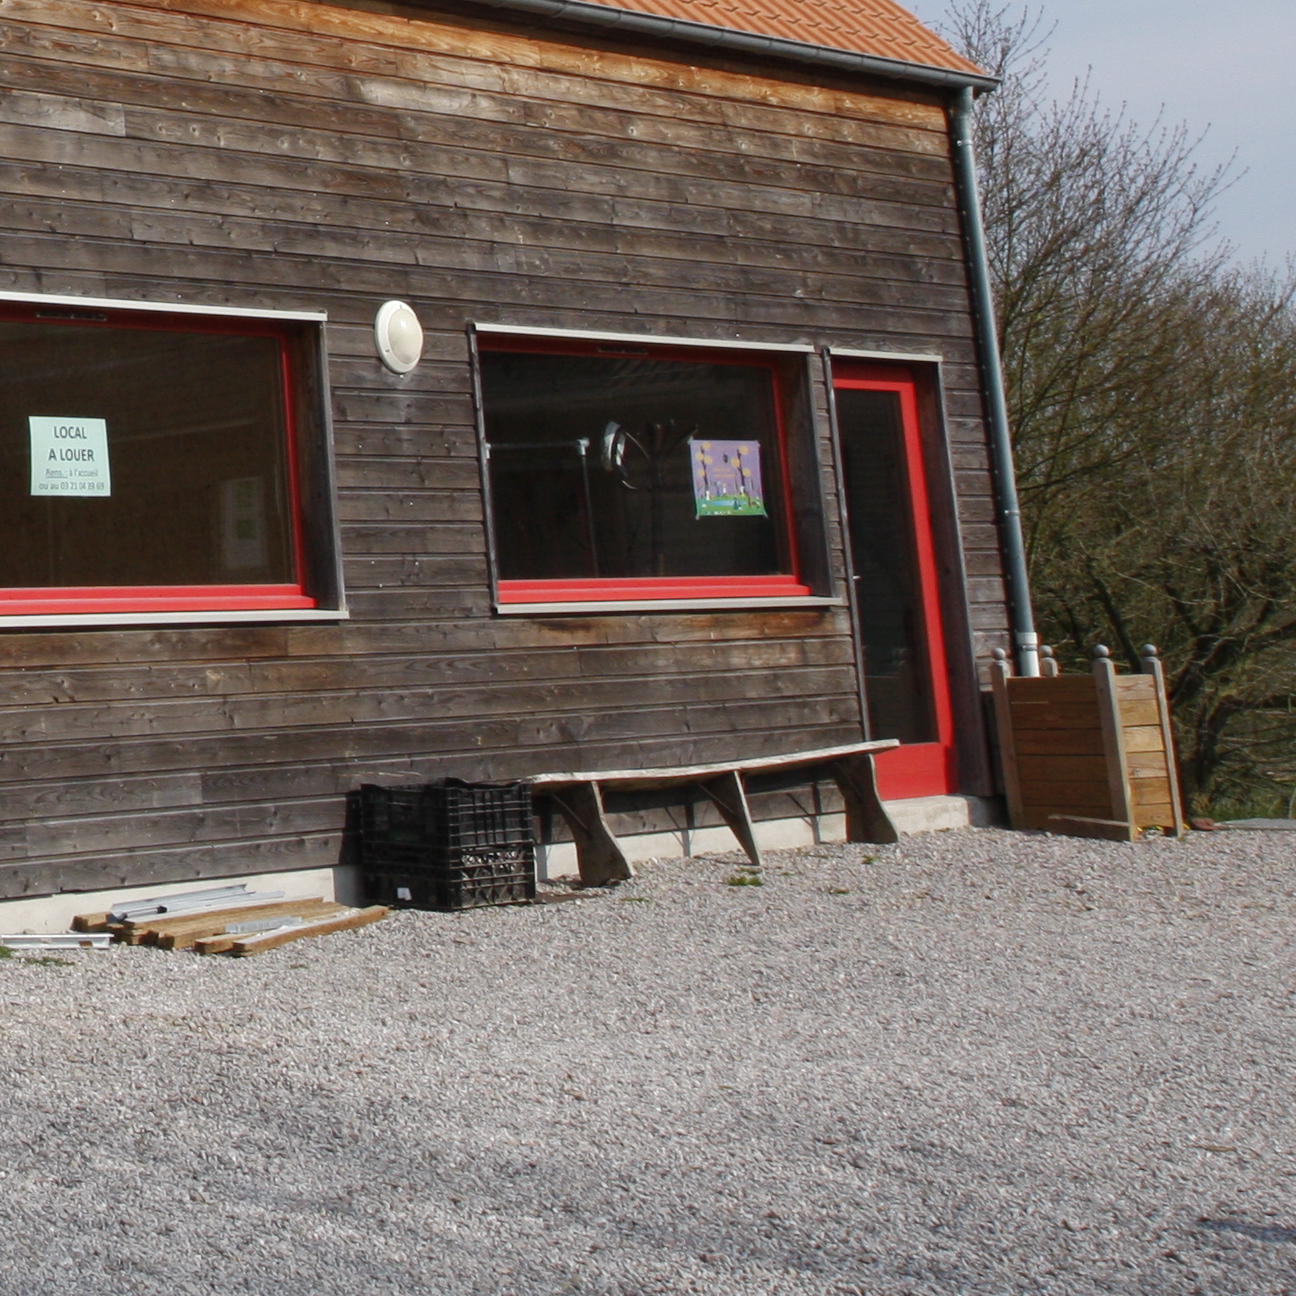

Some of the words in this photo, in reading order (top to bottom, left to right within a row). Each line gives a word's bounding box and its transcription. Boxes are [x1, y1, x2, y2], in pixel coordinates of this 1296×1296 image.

[53, 426, 87, 439] LOCAL
[48, 448, 57, 461] A
[60, 448, 95, 462] LOUER
